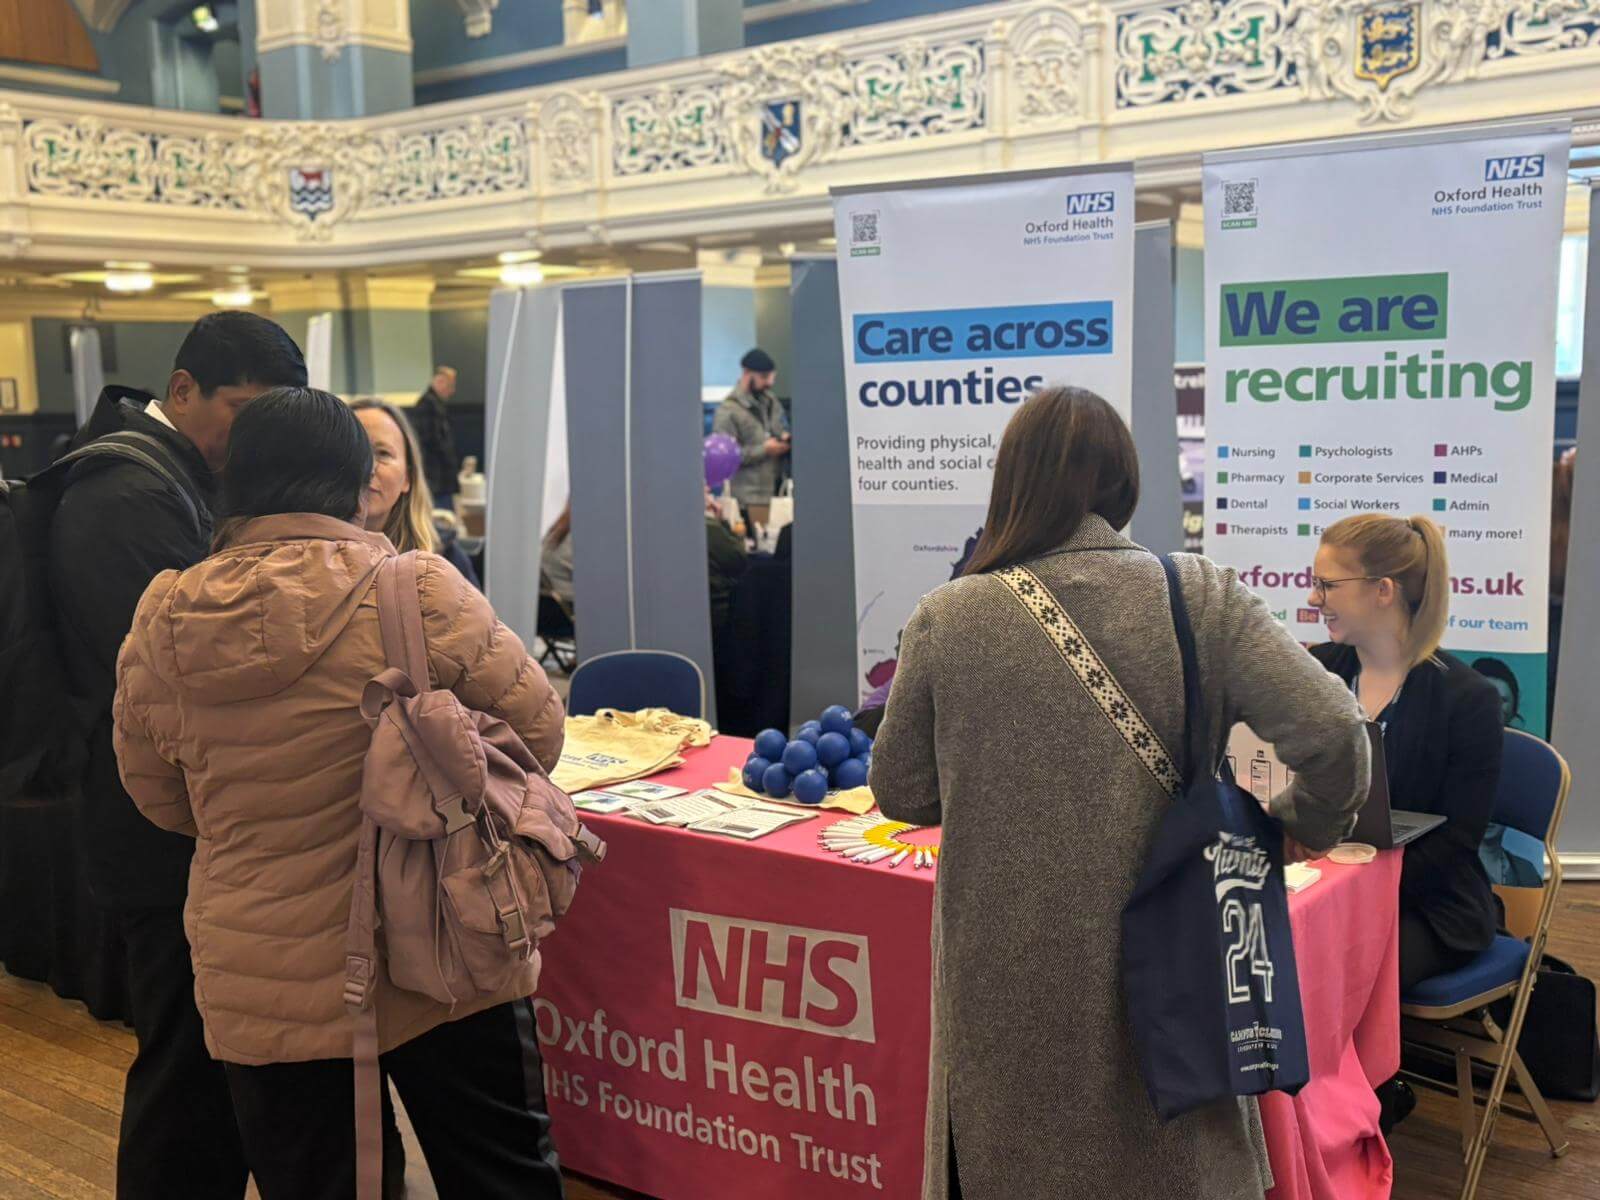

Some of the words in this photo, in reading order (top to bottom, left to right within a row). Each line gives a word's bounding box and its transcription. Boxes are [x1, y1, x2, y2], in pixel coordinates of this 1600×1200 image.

[1487, 156, 1542, 179] NHS
[1434, 187, 1487, 203] Oxford
[1492, 182, 1543, 198] Health
[1068, 193, 1113, 214] NHS
[1431, 206, 1453, 216] NHS
[1456, 202, 1514, 214] Foundation
[1517, 200, 1542, 209] Trust
[1025, 220, 1069, 233] Oxford
[1072, 216, 1114, 230] Health
[1024, 237, 1041, 246] NHS
[1043, 234, 1091, 243] Foundation
[1093, 232, 1114, 240] Trust
[1225, 290, 1320, 337] We
[1338, 293, 1439, 333] are
[857, 320, 953, 356] Care
[966, 317, 1109, 352] across
[859, 367, 1043, 408] counties
[1225, 350, 1533, 412] recruiting
[857, 435, 925, 452] Providing
[930, 433, 996, 452] physical,
[1451, 445, 1483, 456] AHPs
[1231, 446, 1276, 459] Nursing
[1315, 445, 1393, 459] Psychologists
[857, 456, 902, 471] health
[907, 455, 936, 470] and
[940, 454, 983, 470] social
[858, 477, 887, 491] four
[891, 477, 958, 491] counties.
[1231, 472, 1285, 485] Pharmacy
[1314, 473, 1373, 485] Corporate
[1376, 472, 1424, 483] Services
[1451, 472, 1498, 484] Medical
[1230, 498, 1268, 509] Dental
[1313, 499, 1348, 510] Social
[1350, 499, 1400, 510] Workers
[1449, 500, 1490, 511] Admin
[1230, 524, 1288, 537] Therapists
[1449, 529, 1482, 541] many
[1485, 529, 1523, 540] more!
[1238, 565, 1313, 589] xford
[1458, 619, 1485, 629] our
[1488, 618, 1529, 631] team
[1222, 900, 1274, 1004] 24
[681, 919, 861, 1028] NHS
[533, 998, 687, 1082] Oxford
[703, 1038, 878, 1126] Health
[598, 1080, 782, 1164] Foundation
[790, 1132, 883, 1190] Trust
